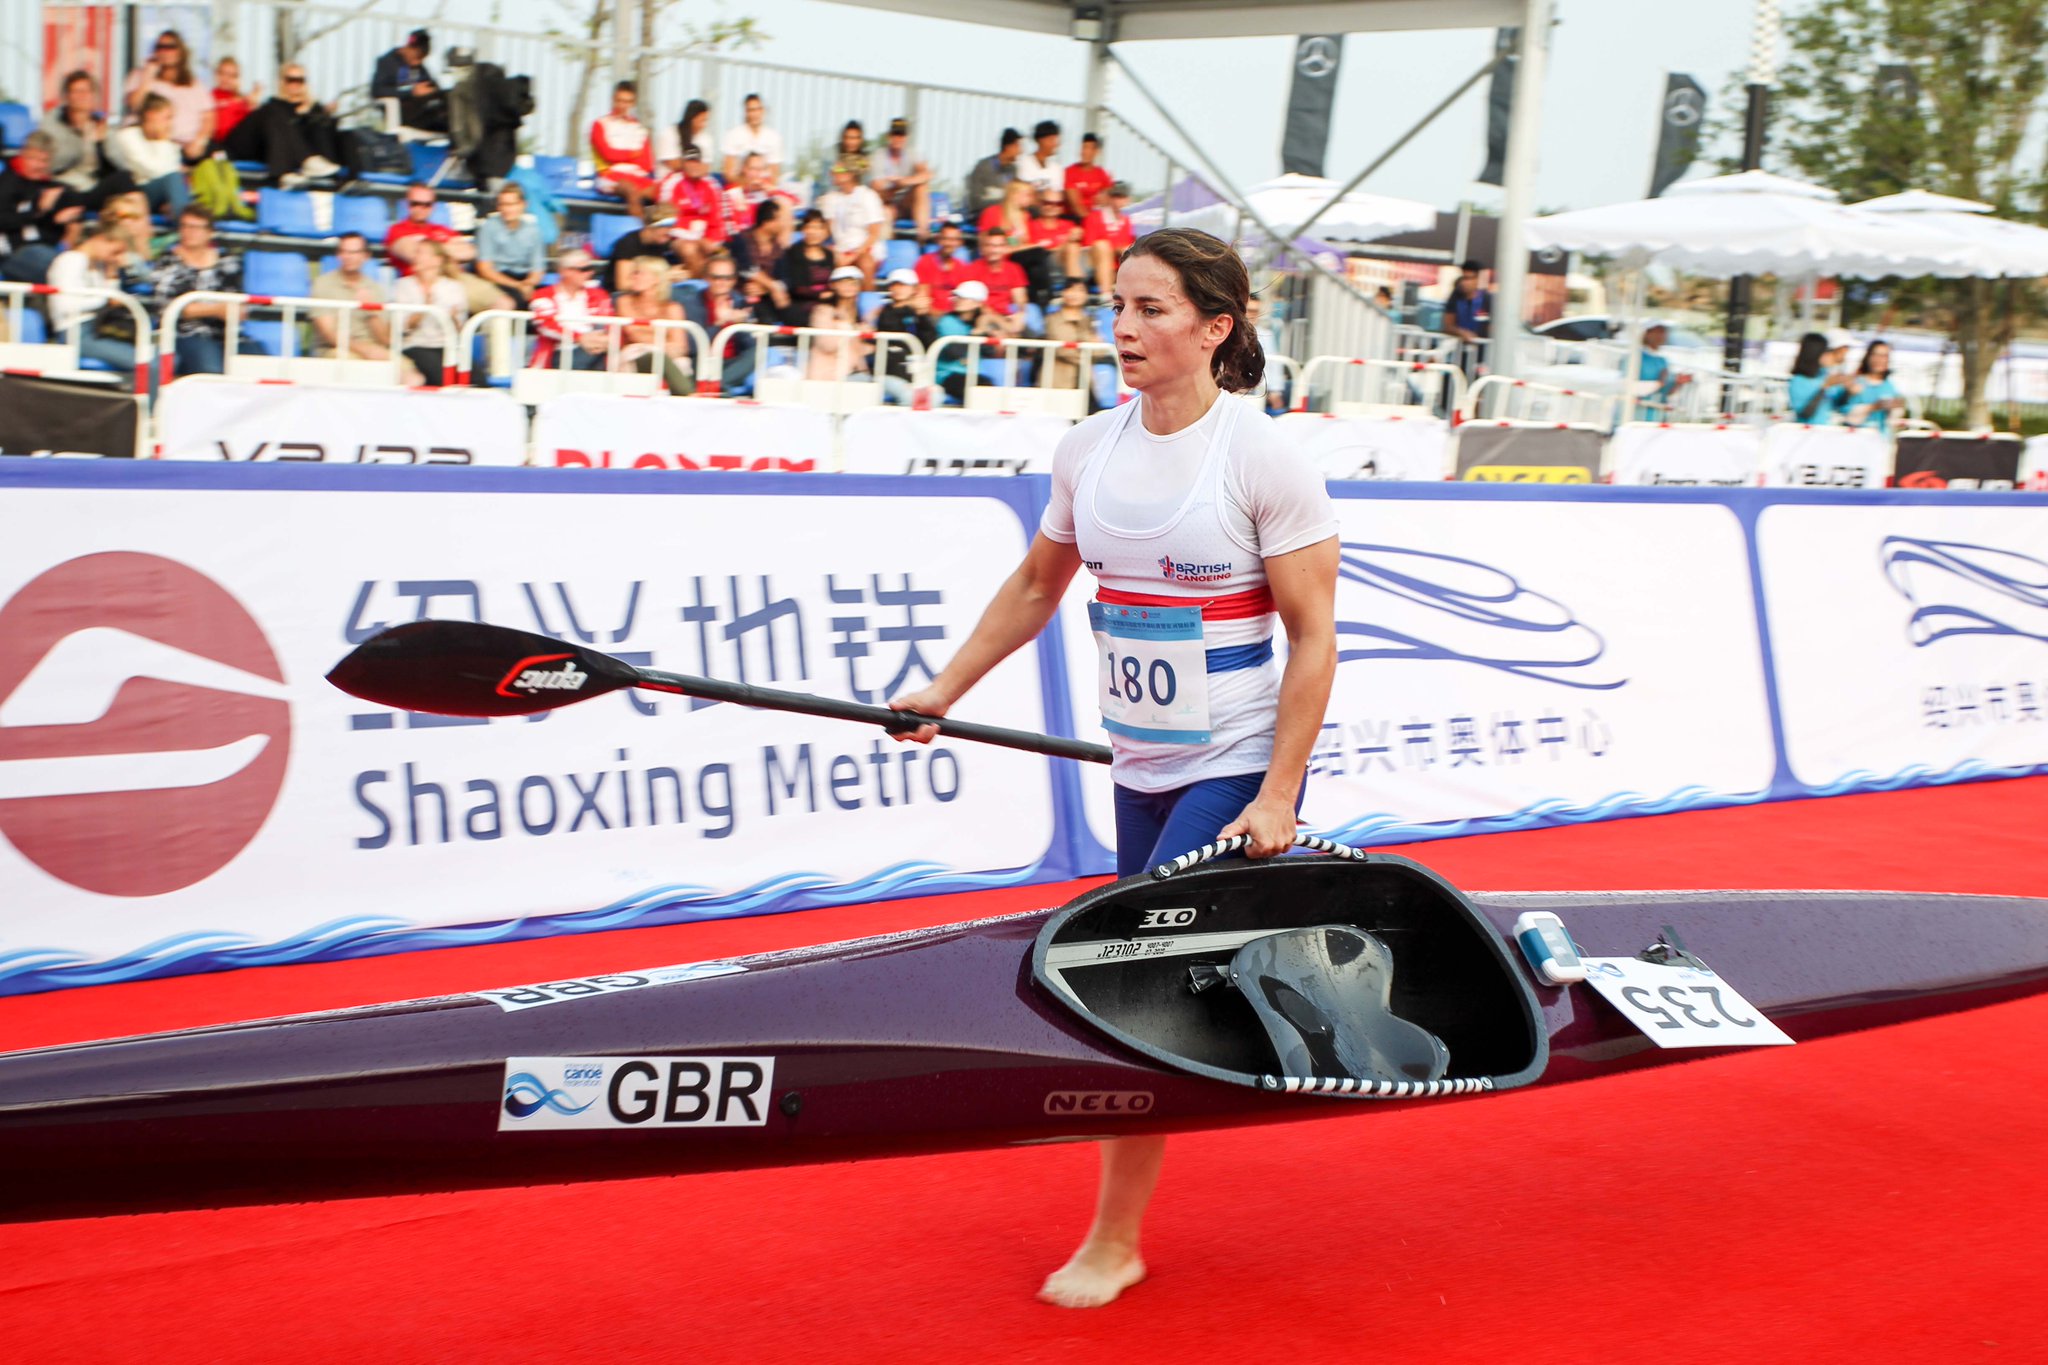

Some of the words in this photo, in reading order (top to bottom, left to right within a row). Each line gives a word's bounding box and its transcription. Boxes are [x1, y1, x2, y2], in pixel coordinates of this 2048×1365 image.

[1176, 562, 1231, 573] BRITISH
[1176, 573, 1231, 582] CANOEING
[513, 661, 588, 694] epic
[1108, 652, 1176, 706] 180
[353, 749, 735, 850] Shaoxing
[765, 740, 961, 815] Metro
[1144, 911, 1193, 925] ELO
[493, 975, 650, 1005] GBR
[1622, 986, 1755, 1029] 235
[607, 1061, 763, 1124] GBR
[1049, 1094, 1150, 1112] NELO
